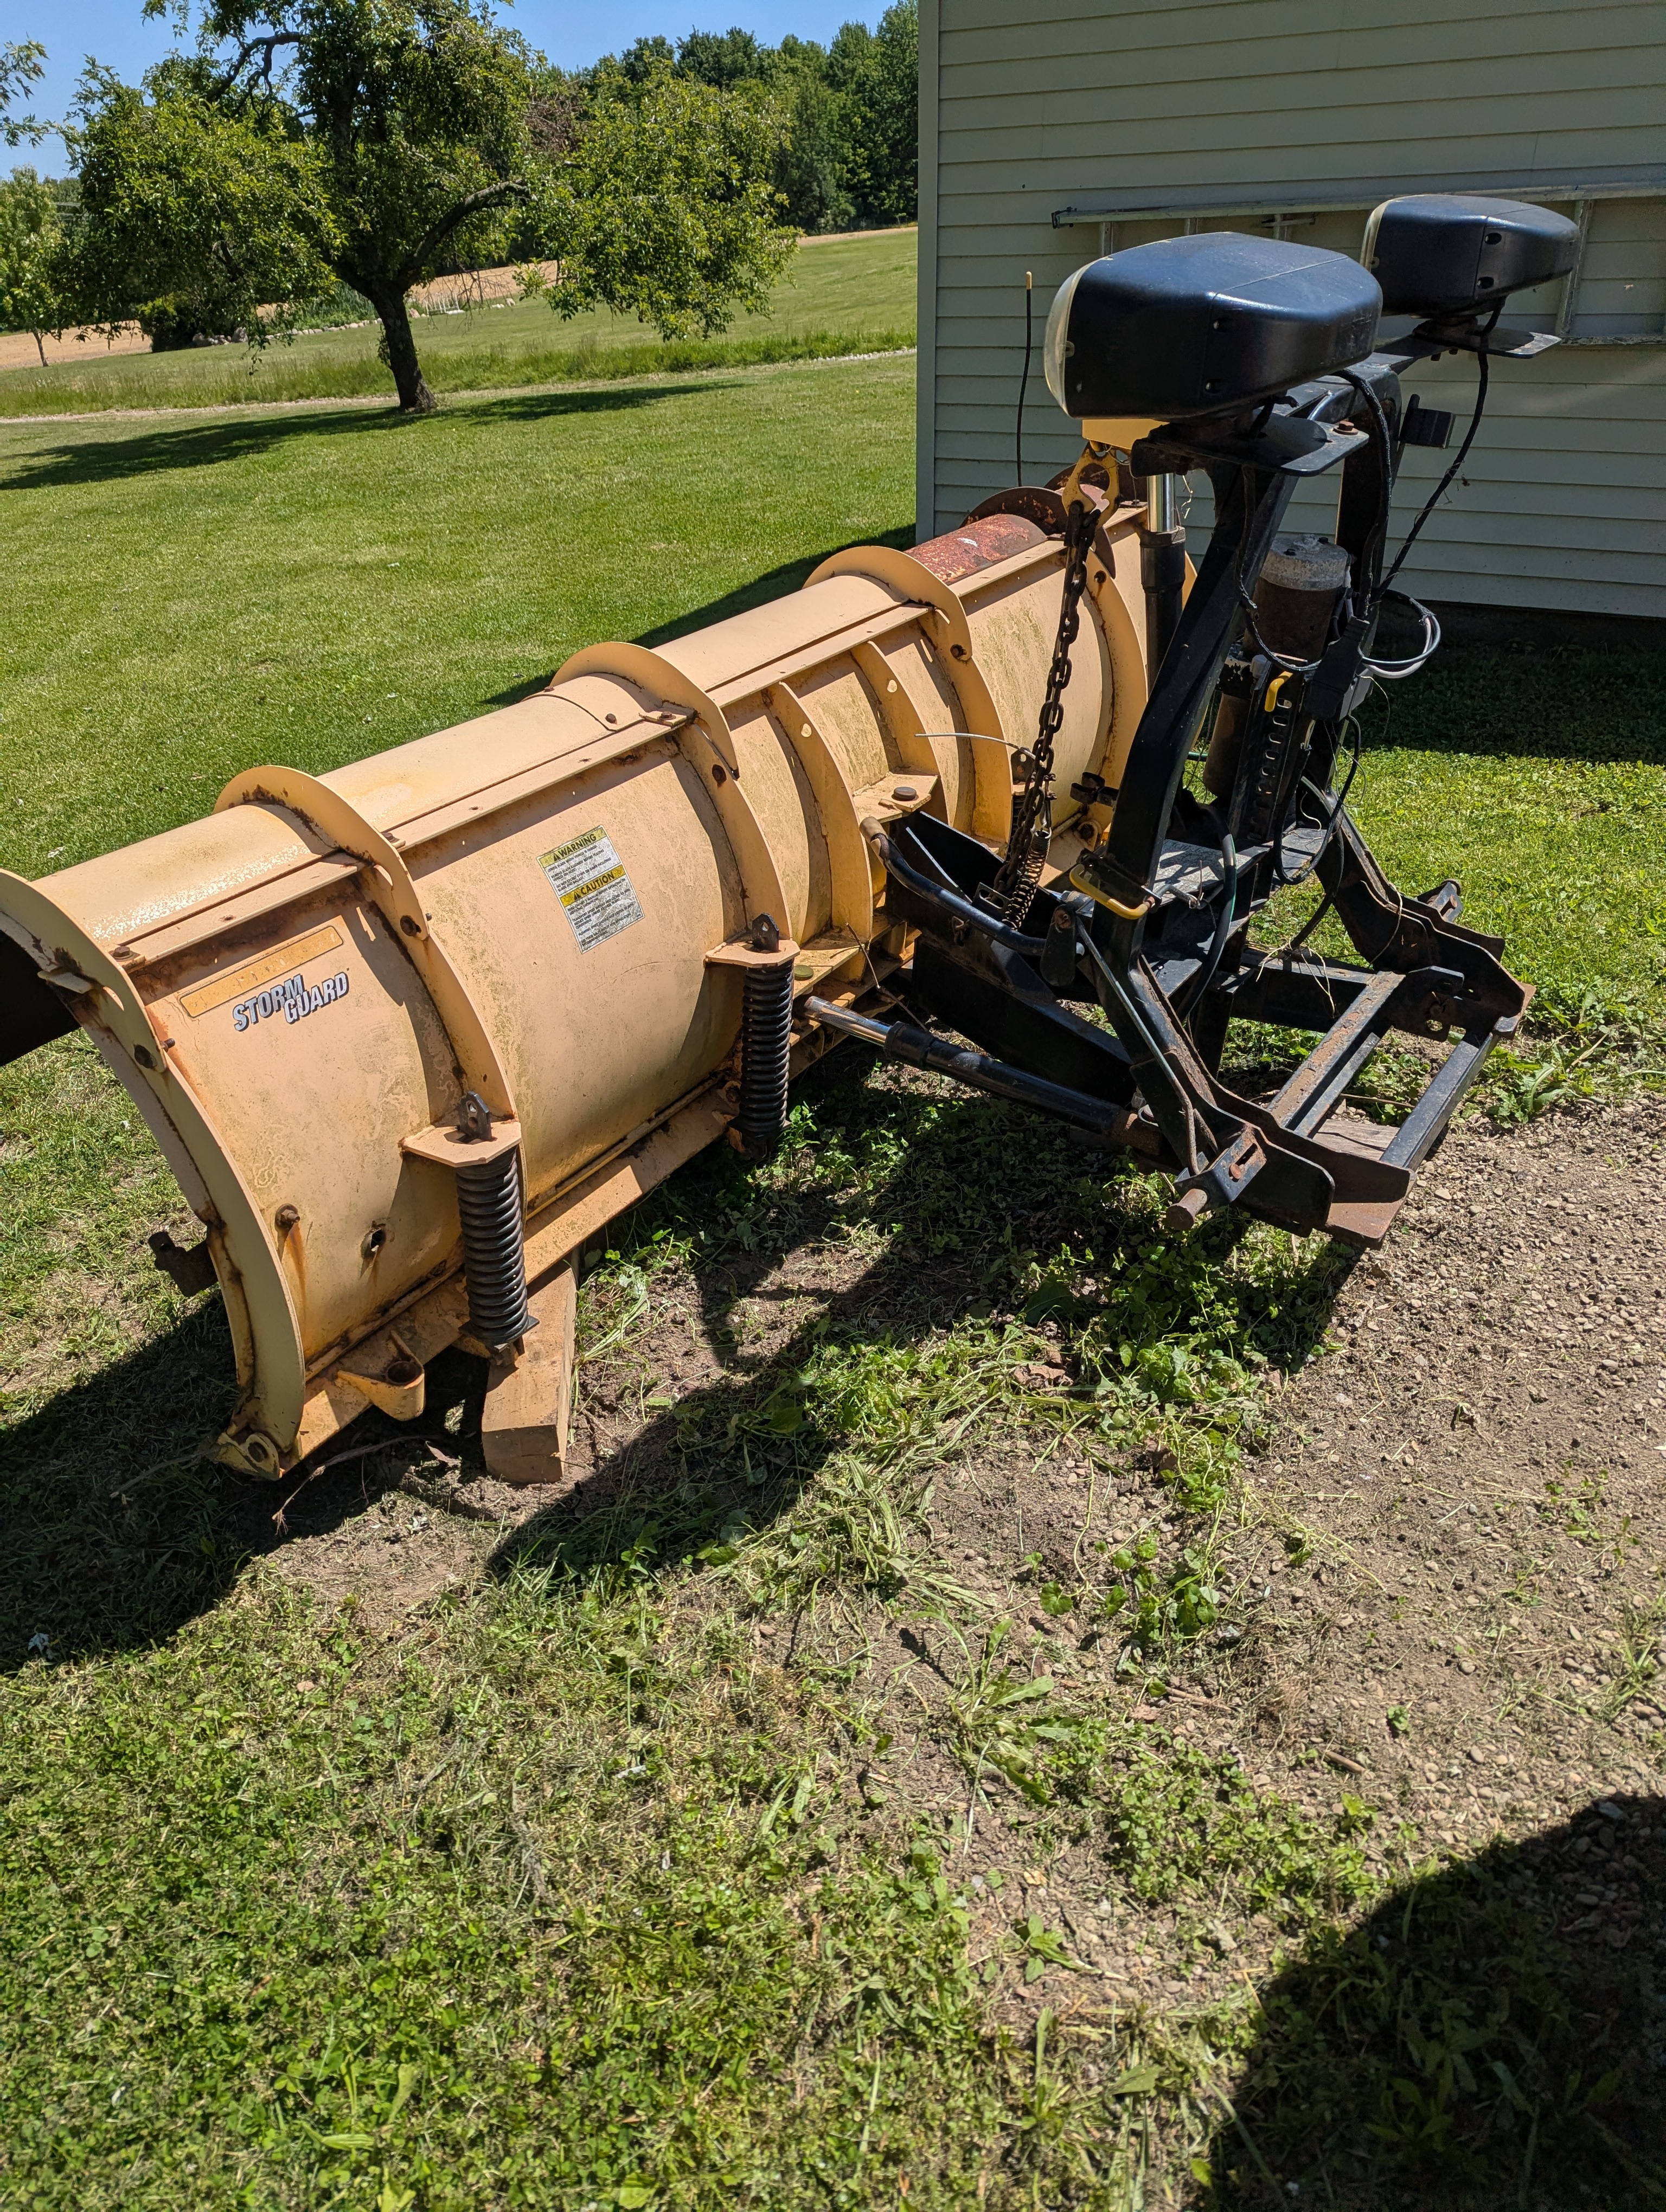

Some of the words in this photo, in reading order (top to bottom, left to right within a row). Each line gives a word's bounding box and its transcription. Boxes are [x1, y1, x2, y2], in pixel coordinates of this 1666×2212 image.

[558, 833, 597, 858] WARNING
[579, 871, 615, 896] CAUTION
[233, 973, 304, 1032] STORM
[283, 972, 350, 1024] GUARD
